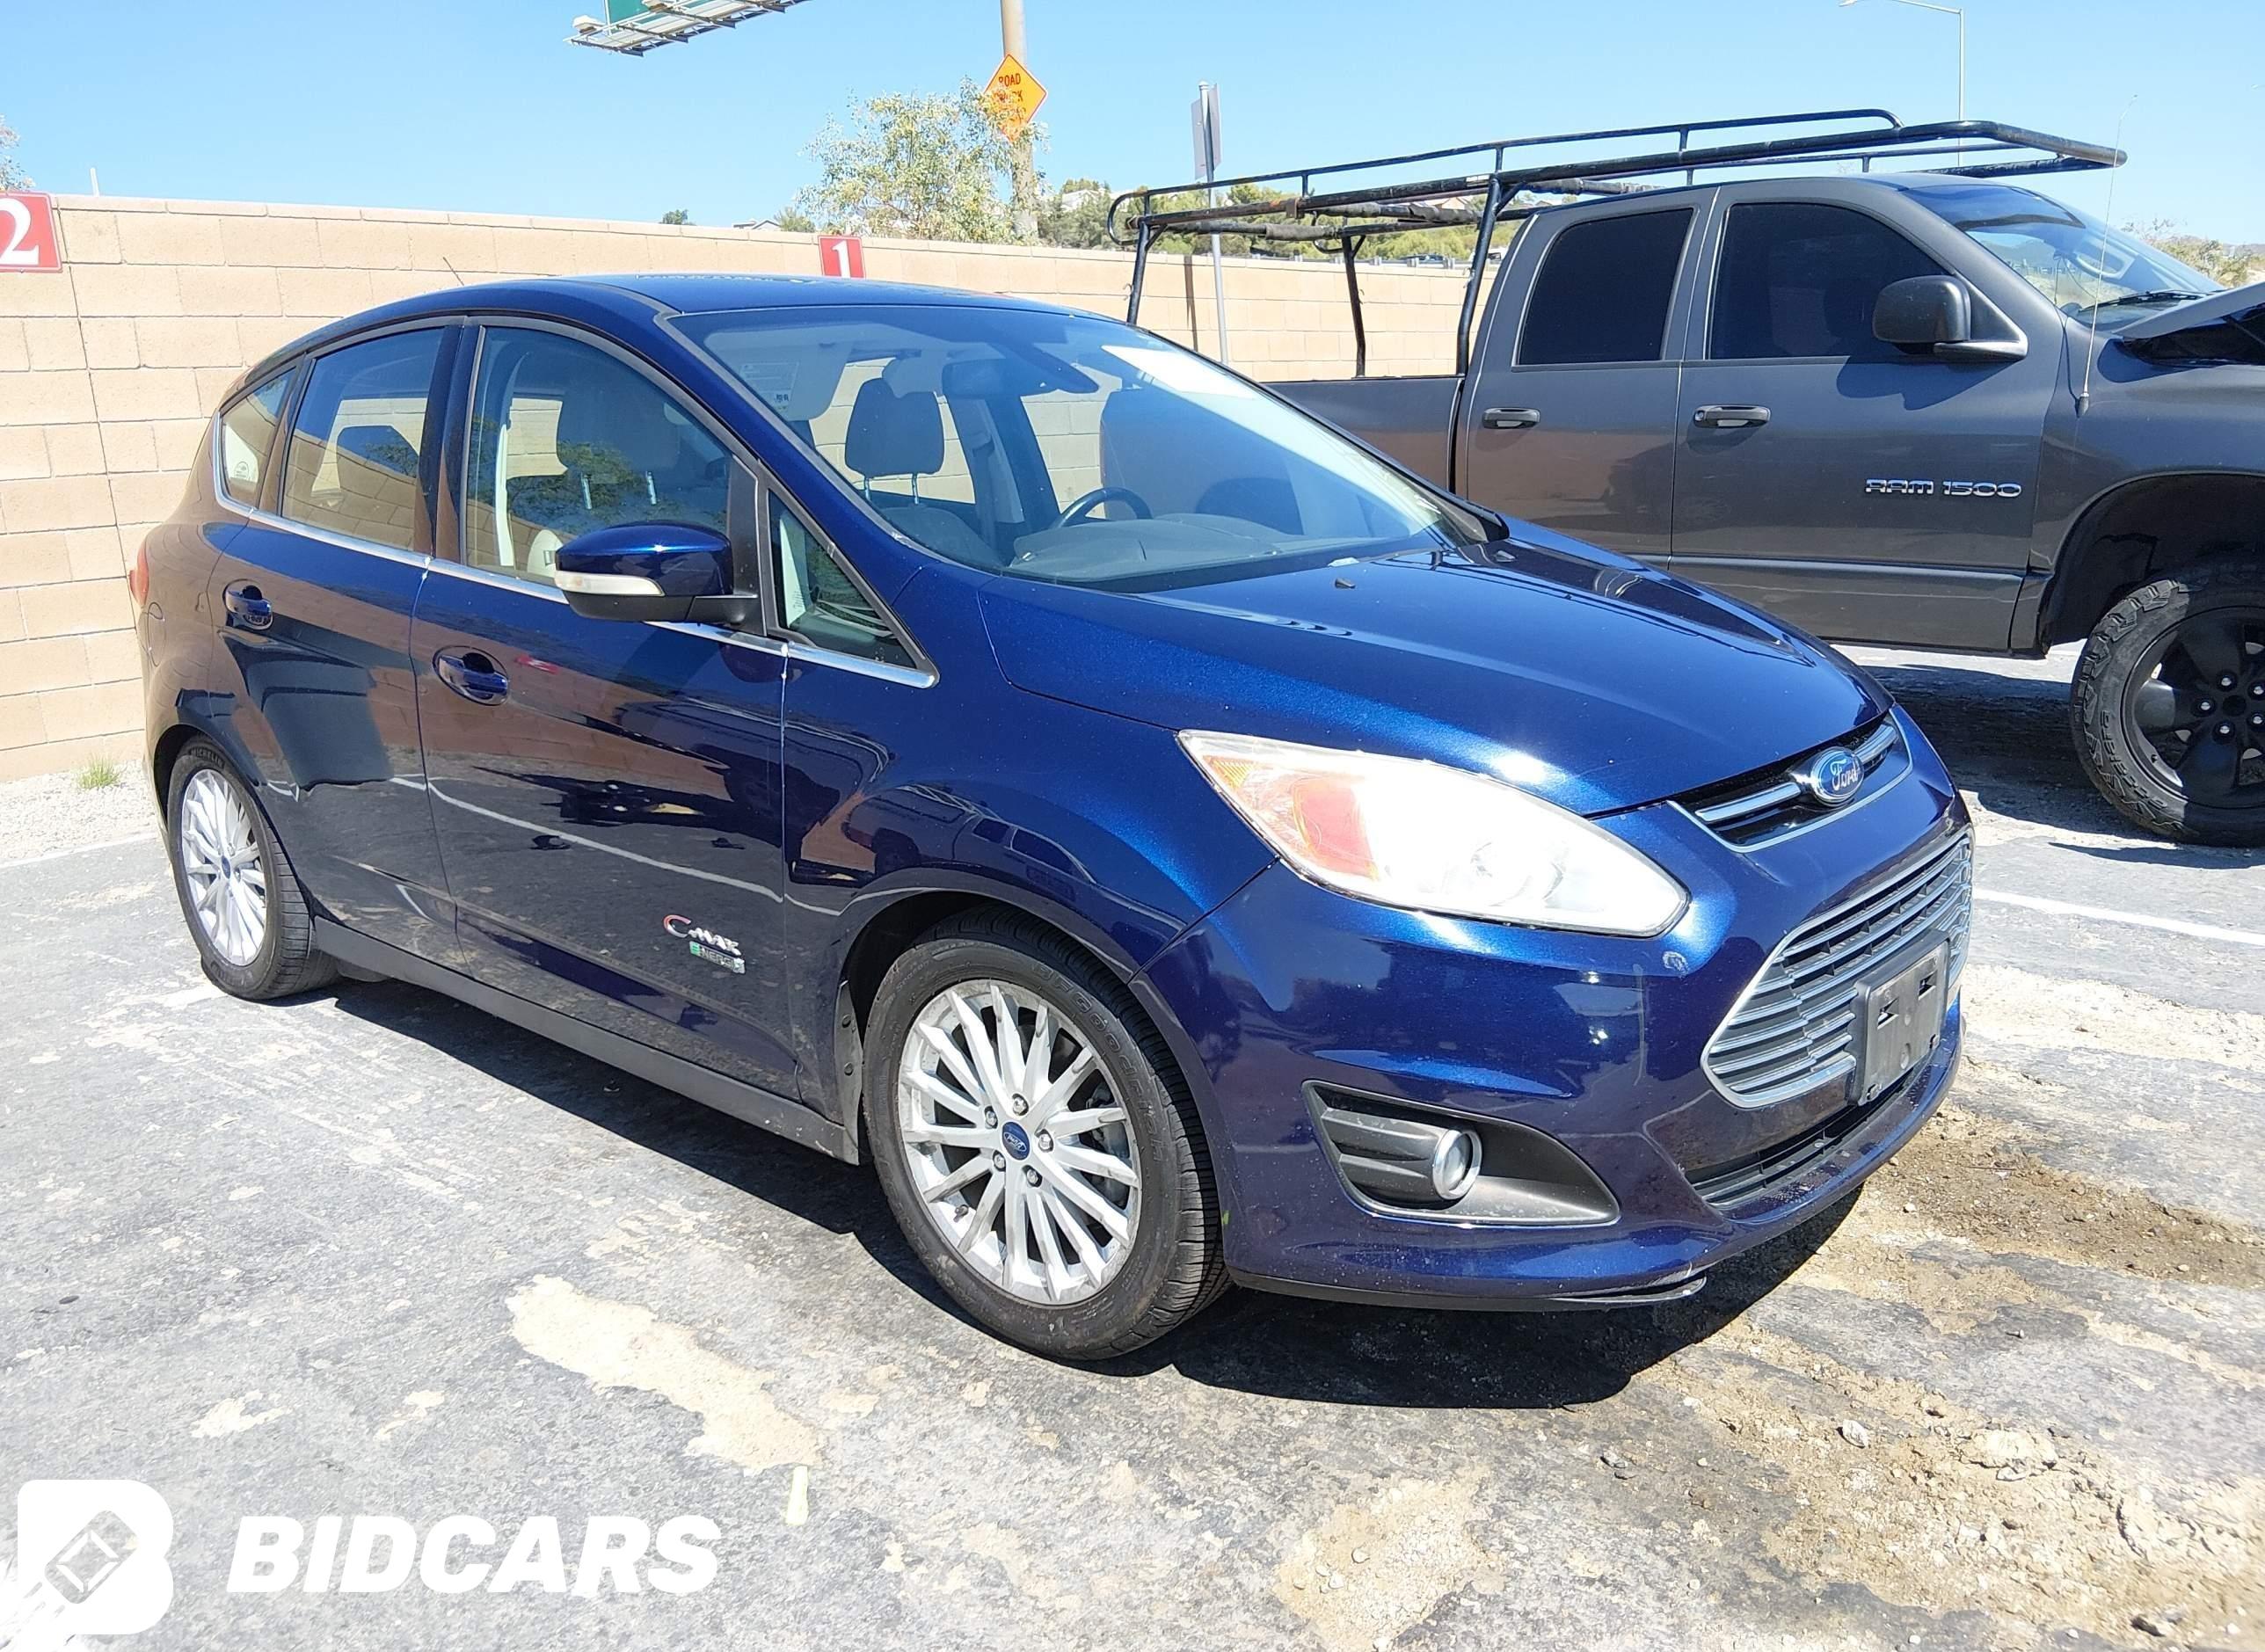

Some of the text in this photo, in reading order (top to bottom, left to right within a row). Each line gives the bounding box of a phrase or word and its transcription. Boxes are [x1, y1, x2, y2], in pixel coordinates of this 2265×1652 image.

[831, 239, 851, 278] 1
[1865, 479, 2022, 498] RAM 1500
[1829, 758, 1862, 791] Ford
